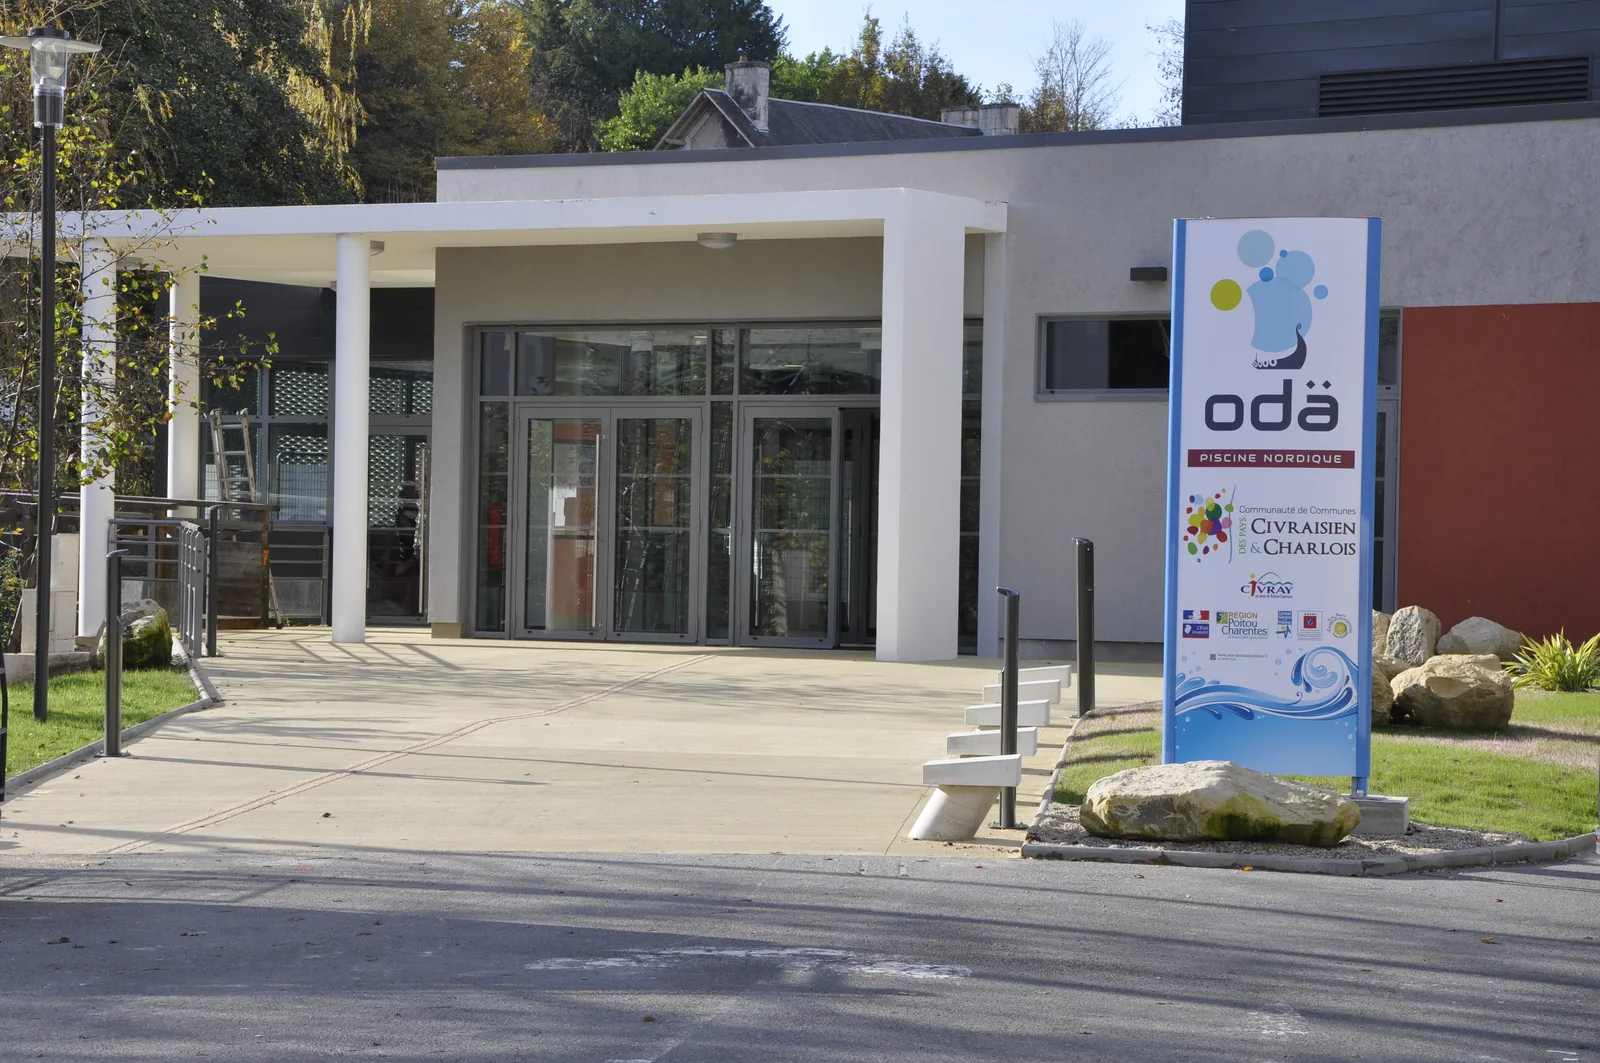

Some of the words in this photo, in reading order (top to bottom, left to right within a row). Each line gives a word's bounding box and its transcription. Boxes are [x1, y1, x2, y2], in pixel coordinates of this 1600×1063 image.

[1204, 378, 1339, 432] odä
[1200, 453, 1257, 463] PISCINE
[1264, 453, 1342, 464] NORDIQUE
[1239, 505, 1296, 515] Communauté
[1297, 506, 1308, 515] de
[1309, 506, 1357, 515] Communes
[1238, 517, 1247, 536] PAYS
[1251, 517, 1356, 535] CIVRAISIEN
[1238, 537, 1247, 554] DES
[1250, 541, 1261, 554] &
[1263, 538, 1356, 556] CHARLOIS
[1221, 625, 1268, 635] Charentes
[1228, 618, 1258, 628] Poitou
